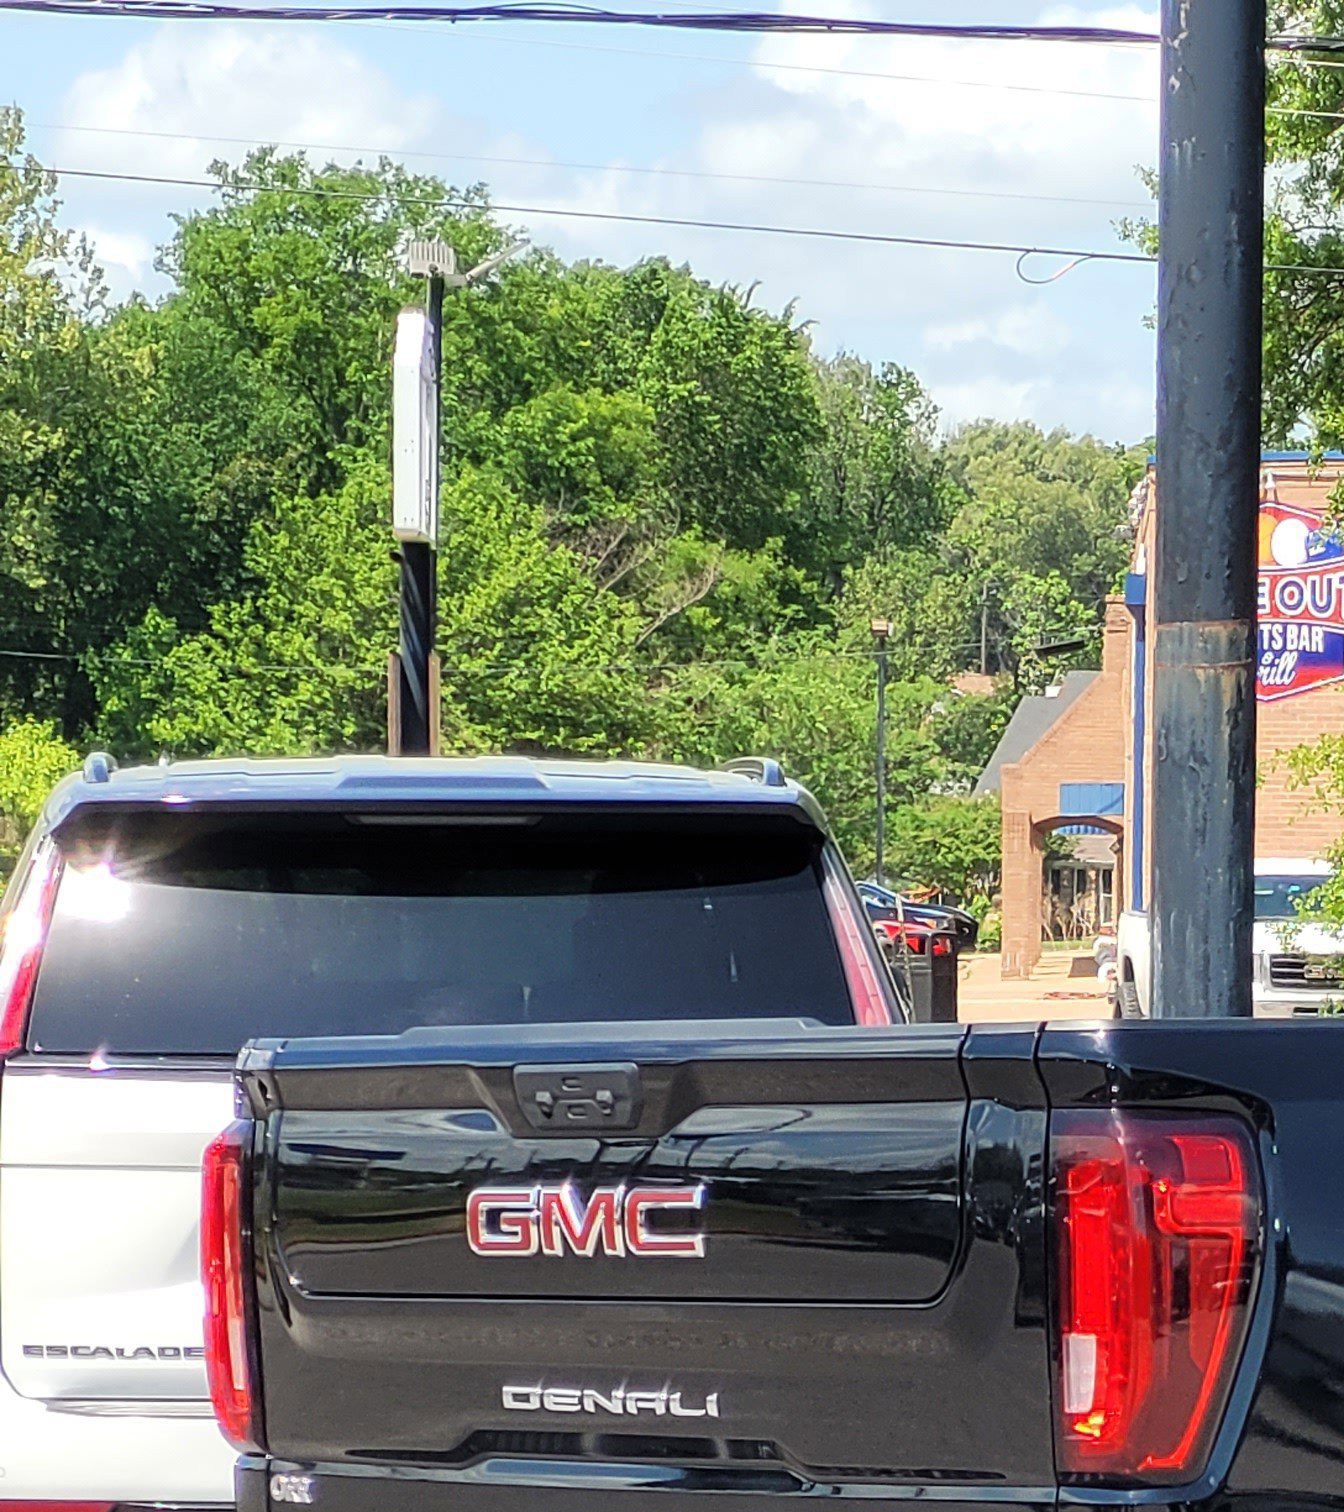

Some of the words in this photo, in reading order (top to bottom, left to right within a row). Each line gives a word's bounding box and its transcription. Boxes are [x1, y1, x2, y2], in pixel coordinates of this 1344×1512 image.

[1259, 623, 1283, 651] TS
[1286, 624, 1325, 653] BAR
[1257, 651, 1298, 687] rill
[466, 1184, 706, 1258] GMC
[22, 1344, 207, 1360] ESCALADE
[502, 1384, 720, 1418] DENALI
[270, 1474, 314, 1504] ORR
